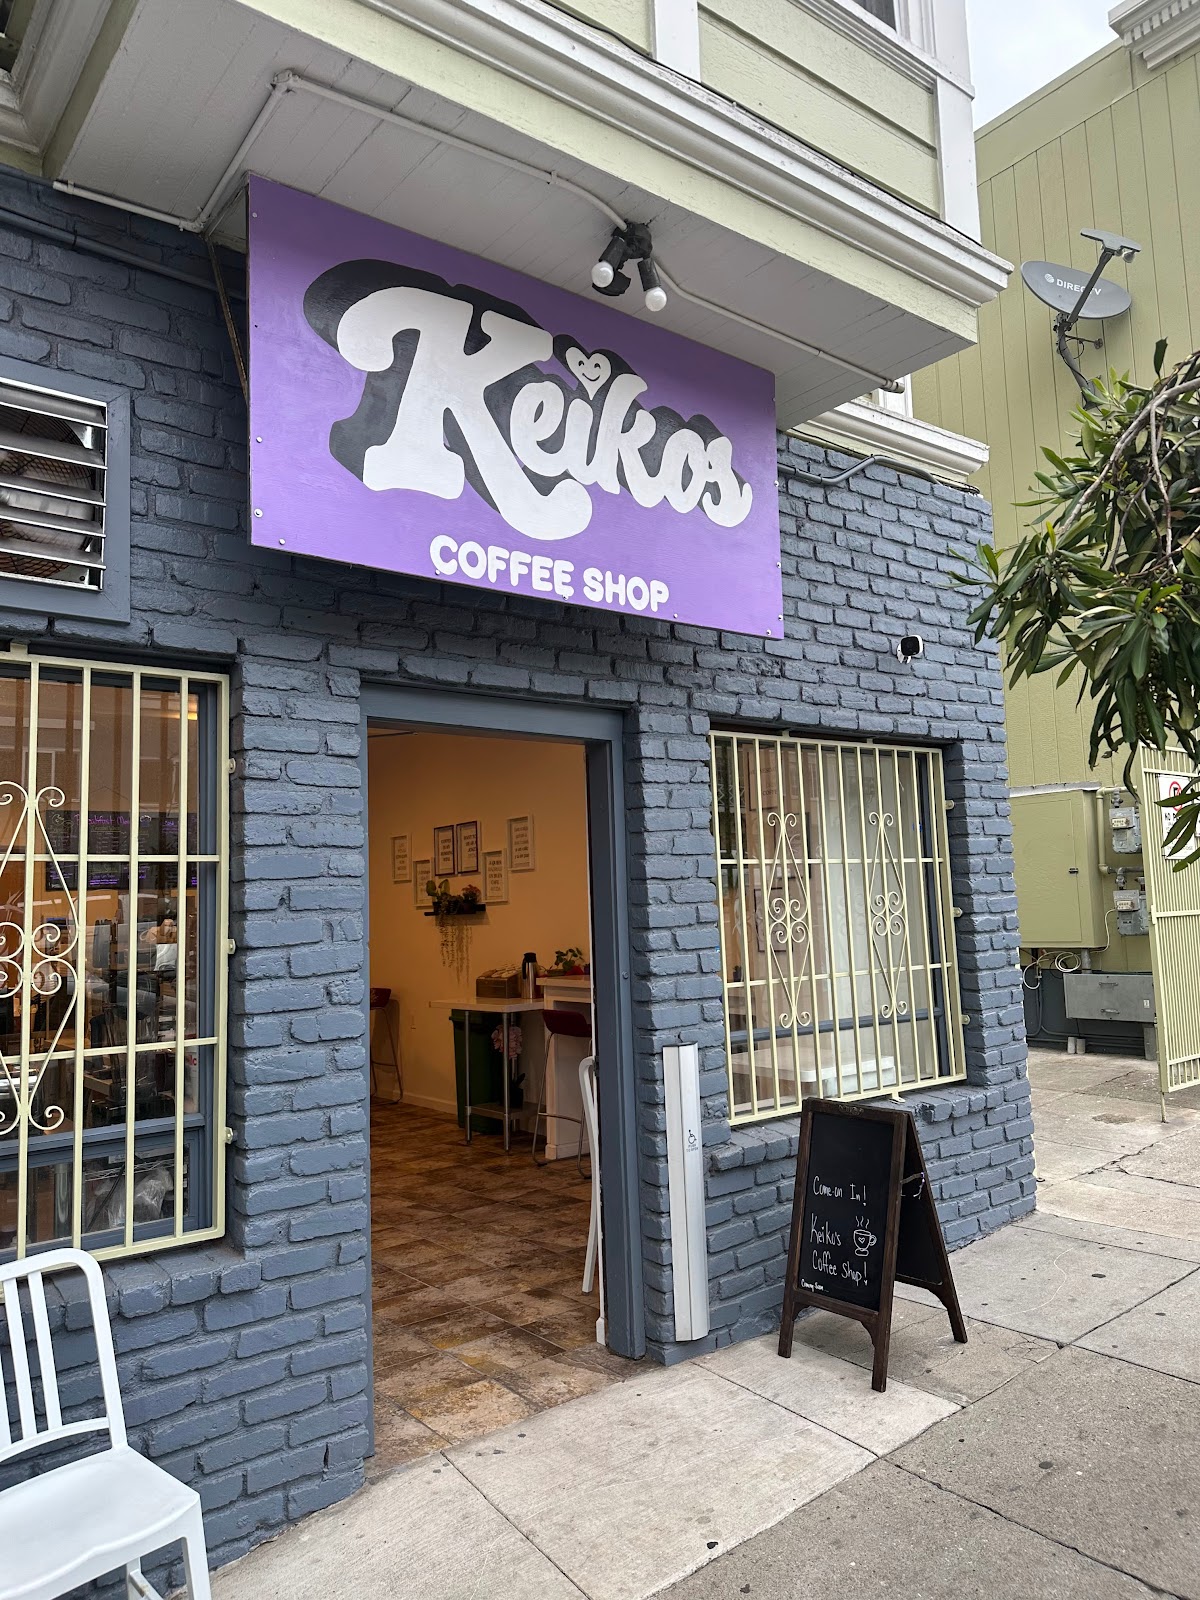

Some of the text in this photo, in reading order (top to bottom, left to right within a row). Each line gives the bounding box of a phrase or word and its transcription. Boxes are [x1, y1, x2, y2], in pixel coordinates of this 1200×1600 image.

[1056, 279, 1102, 295] DIRECV
[336, 285, 753, 541] Keikos
[429, 534, 670, 613] COFFEE SHOP
[849, 1183, 867, 1207] In!
[809, 1212, 842, 1247] Keiko's
[812, 1249, 869, 1287] Coffee Shop!
